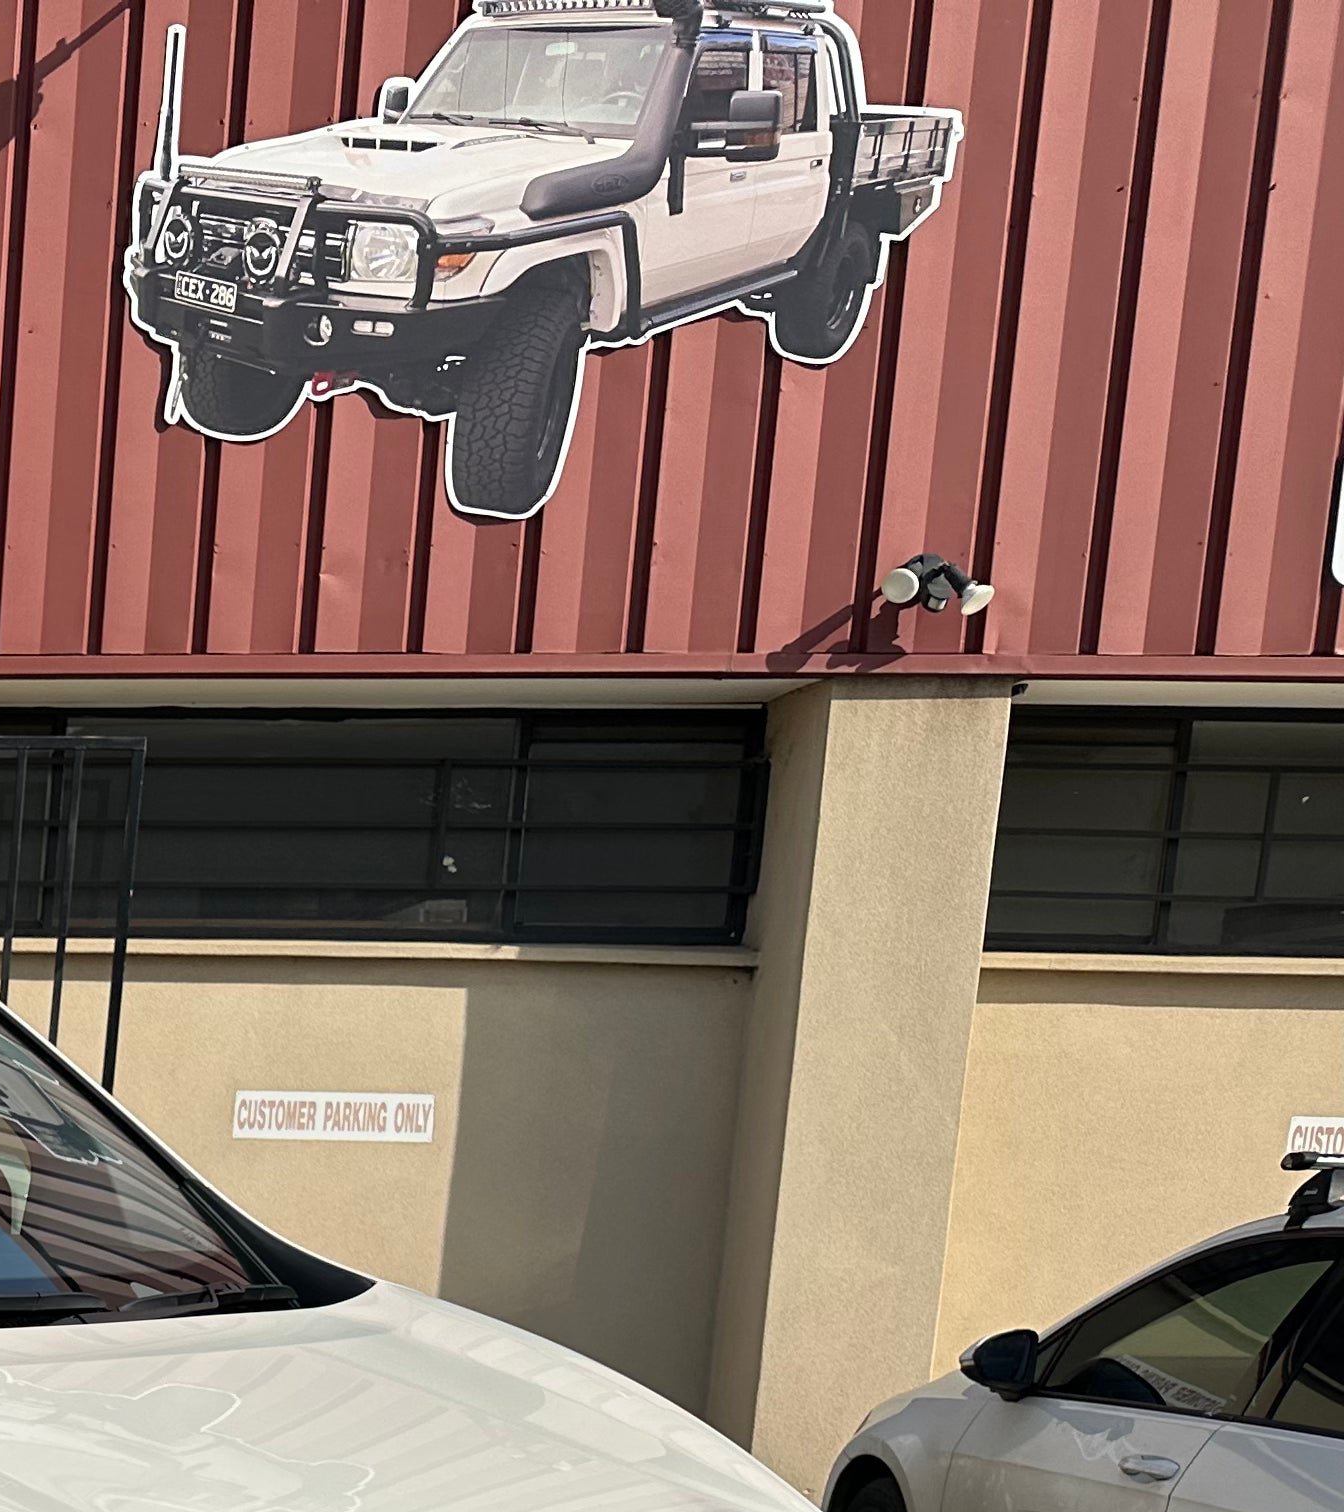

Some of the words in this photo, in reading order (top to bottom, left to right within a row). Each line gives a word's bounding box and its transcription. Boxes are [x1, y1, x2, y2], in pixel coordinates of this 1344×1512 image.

[237, 1098, 317, 1131] CUSTOMER
[322, 1100, 388, 1133] PARKING
[393, 1102, 432, 1133] ONLY
